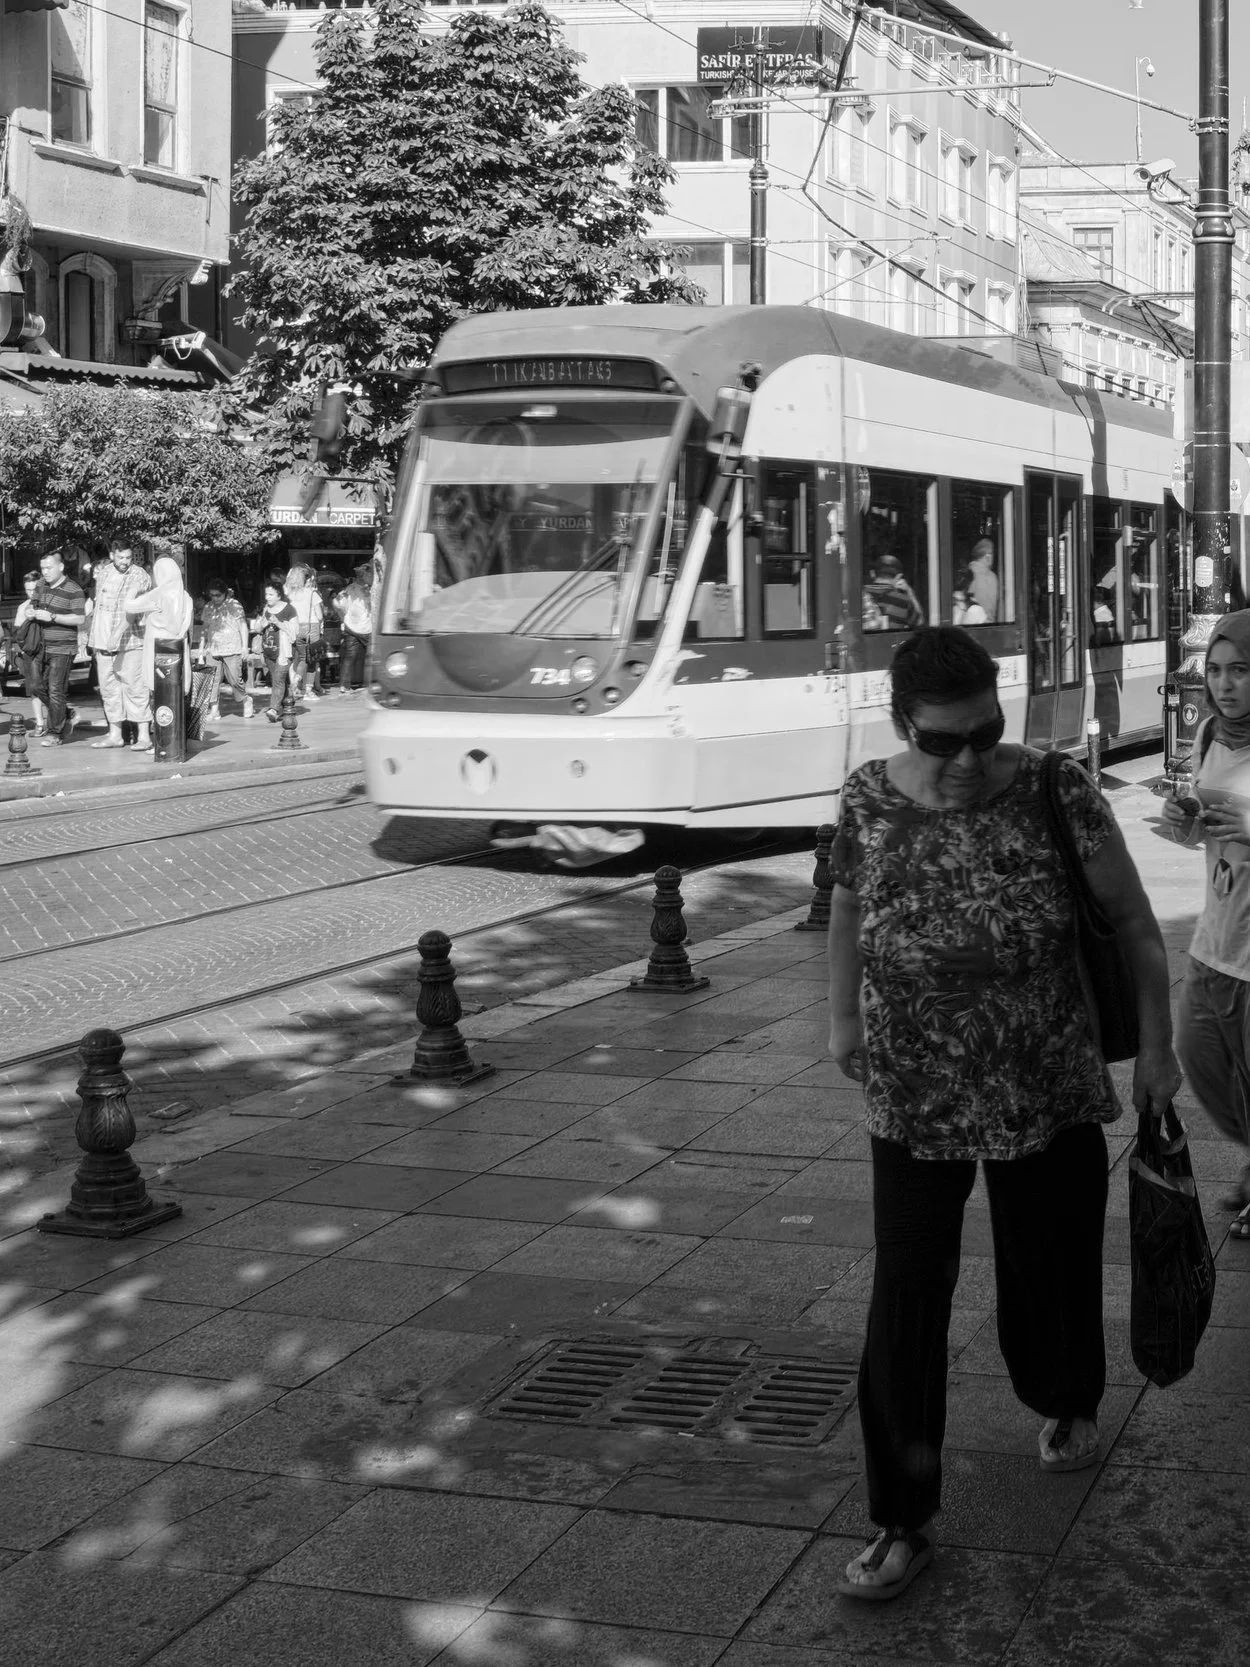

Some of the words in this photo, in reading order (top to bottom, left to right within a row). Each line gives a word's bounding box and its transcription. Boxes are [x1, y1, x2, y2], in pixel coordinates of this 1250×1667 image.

[700, 70, 732, 79] TURKISH
[270, 510, 318, 524] URDAN
[329, 512, 376, 526] CARPET
[530, 667, 571, 686] 734
